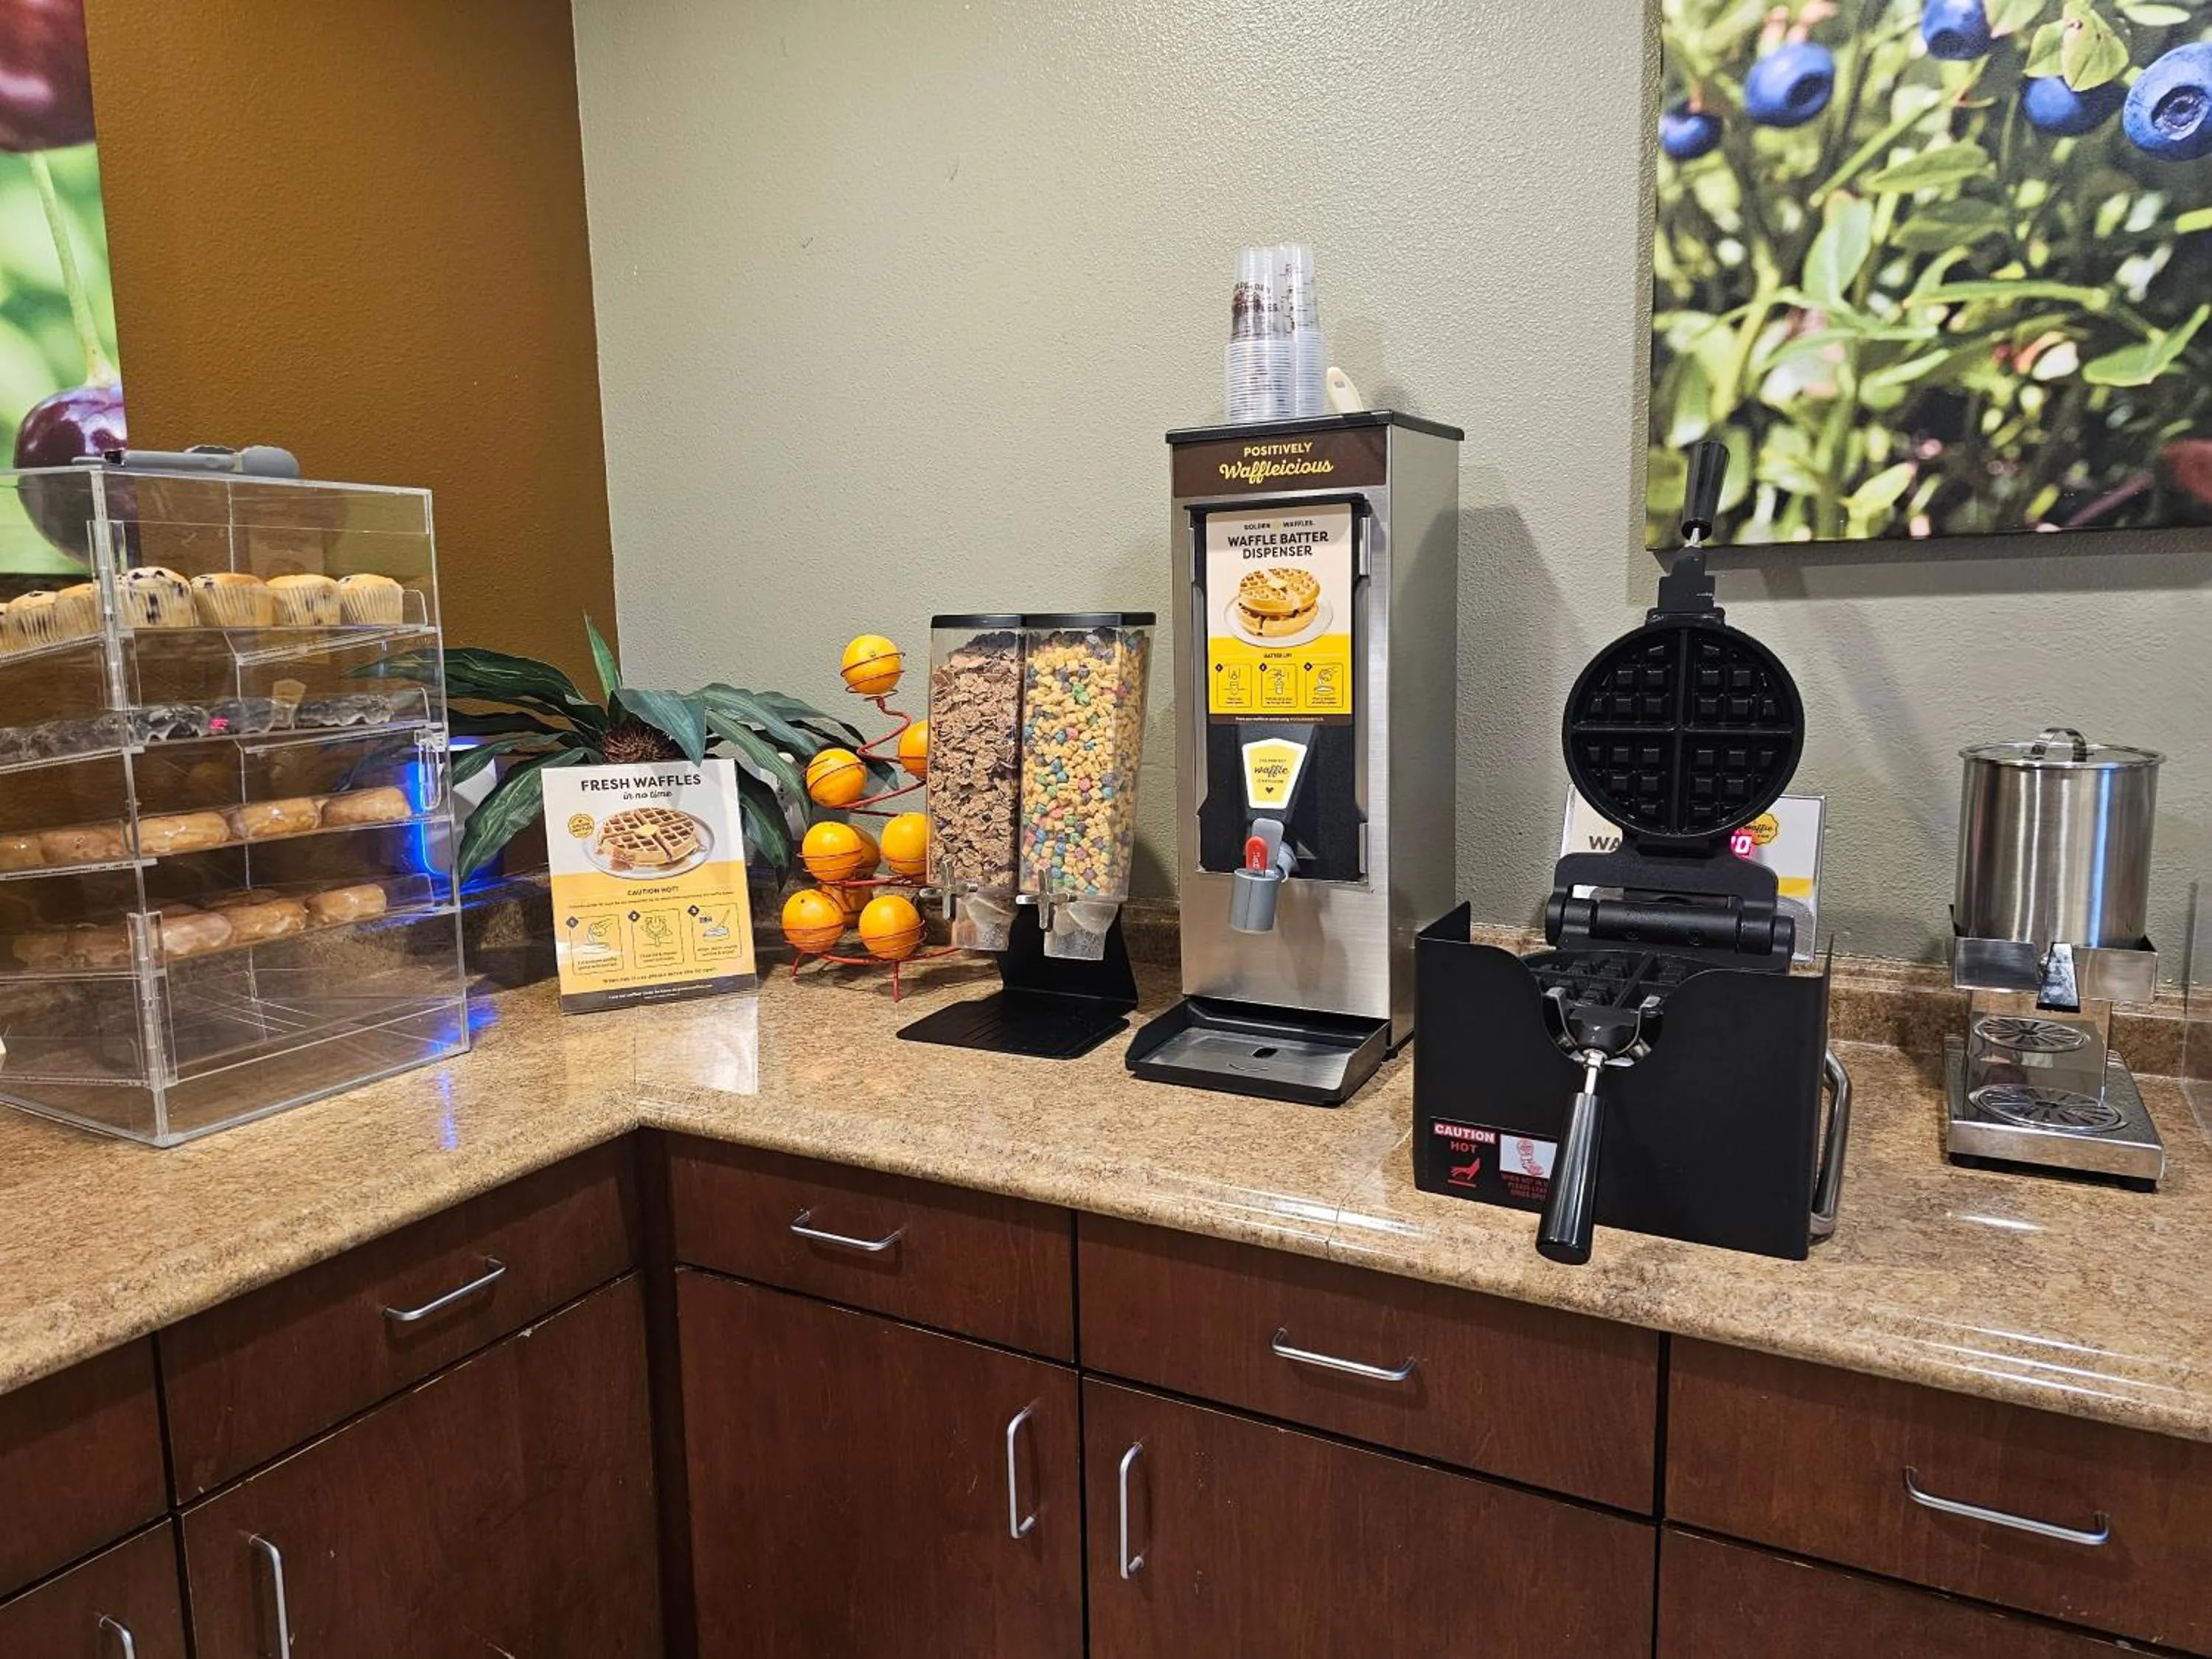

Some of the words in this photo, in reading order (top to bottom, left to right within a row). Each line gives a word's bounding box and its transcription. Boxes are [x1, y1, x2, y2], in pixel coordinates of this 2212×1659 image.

[1244, 442, 1312, 457] POSITIVELY
[1219, 458, 1334, 484] Waffleicious
[1228, 535, 1276, 547] WAFFLE
[1280, 531, 1329, 544] BATTER
[1242, 546, 1312, 559] DISPENSER
[580, 778, 630, 792] FRESH
[633, 774, 701, 787] WAFFLES
[623, 791, 633, 800] in
[650, 790, 672, 799] time
[1433, 1121, 1495, 1144] CAUTION
[1450, 1141, 1478, 1153] HOT
